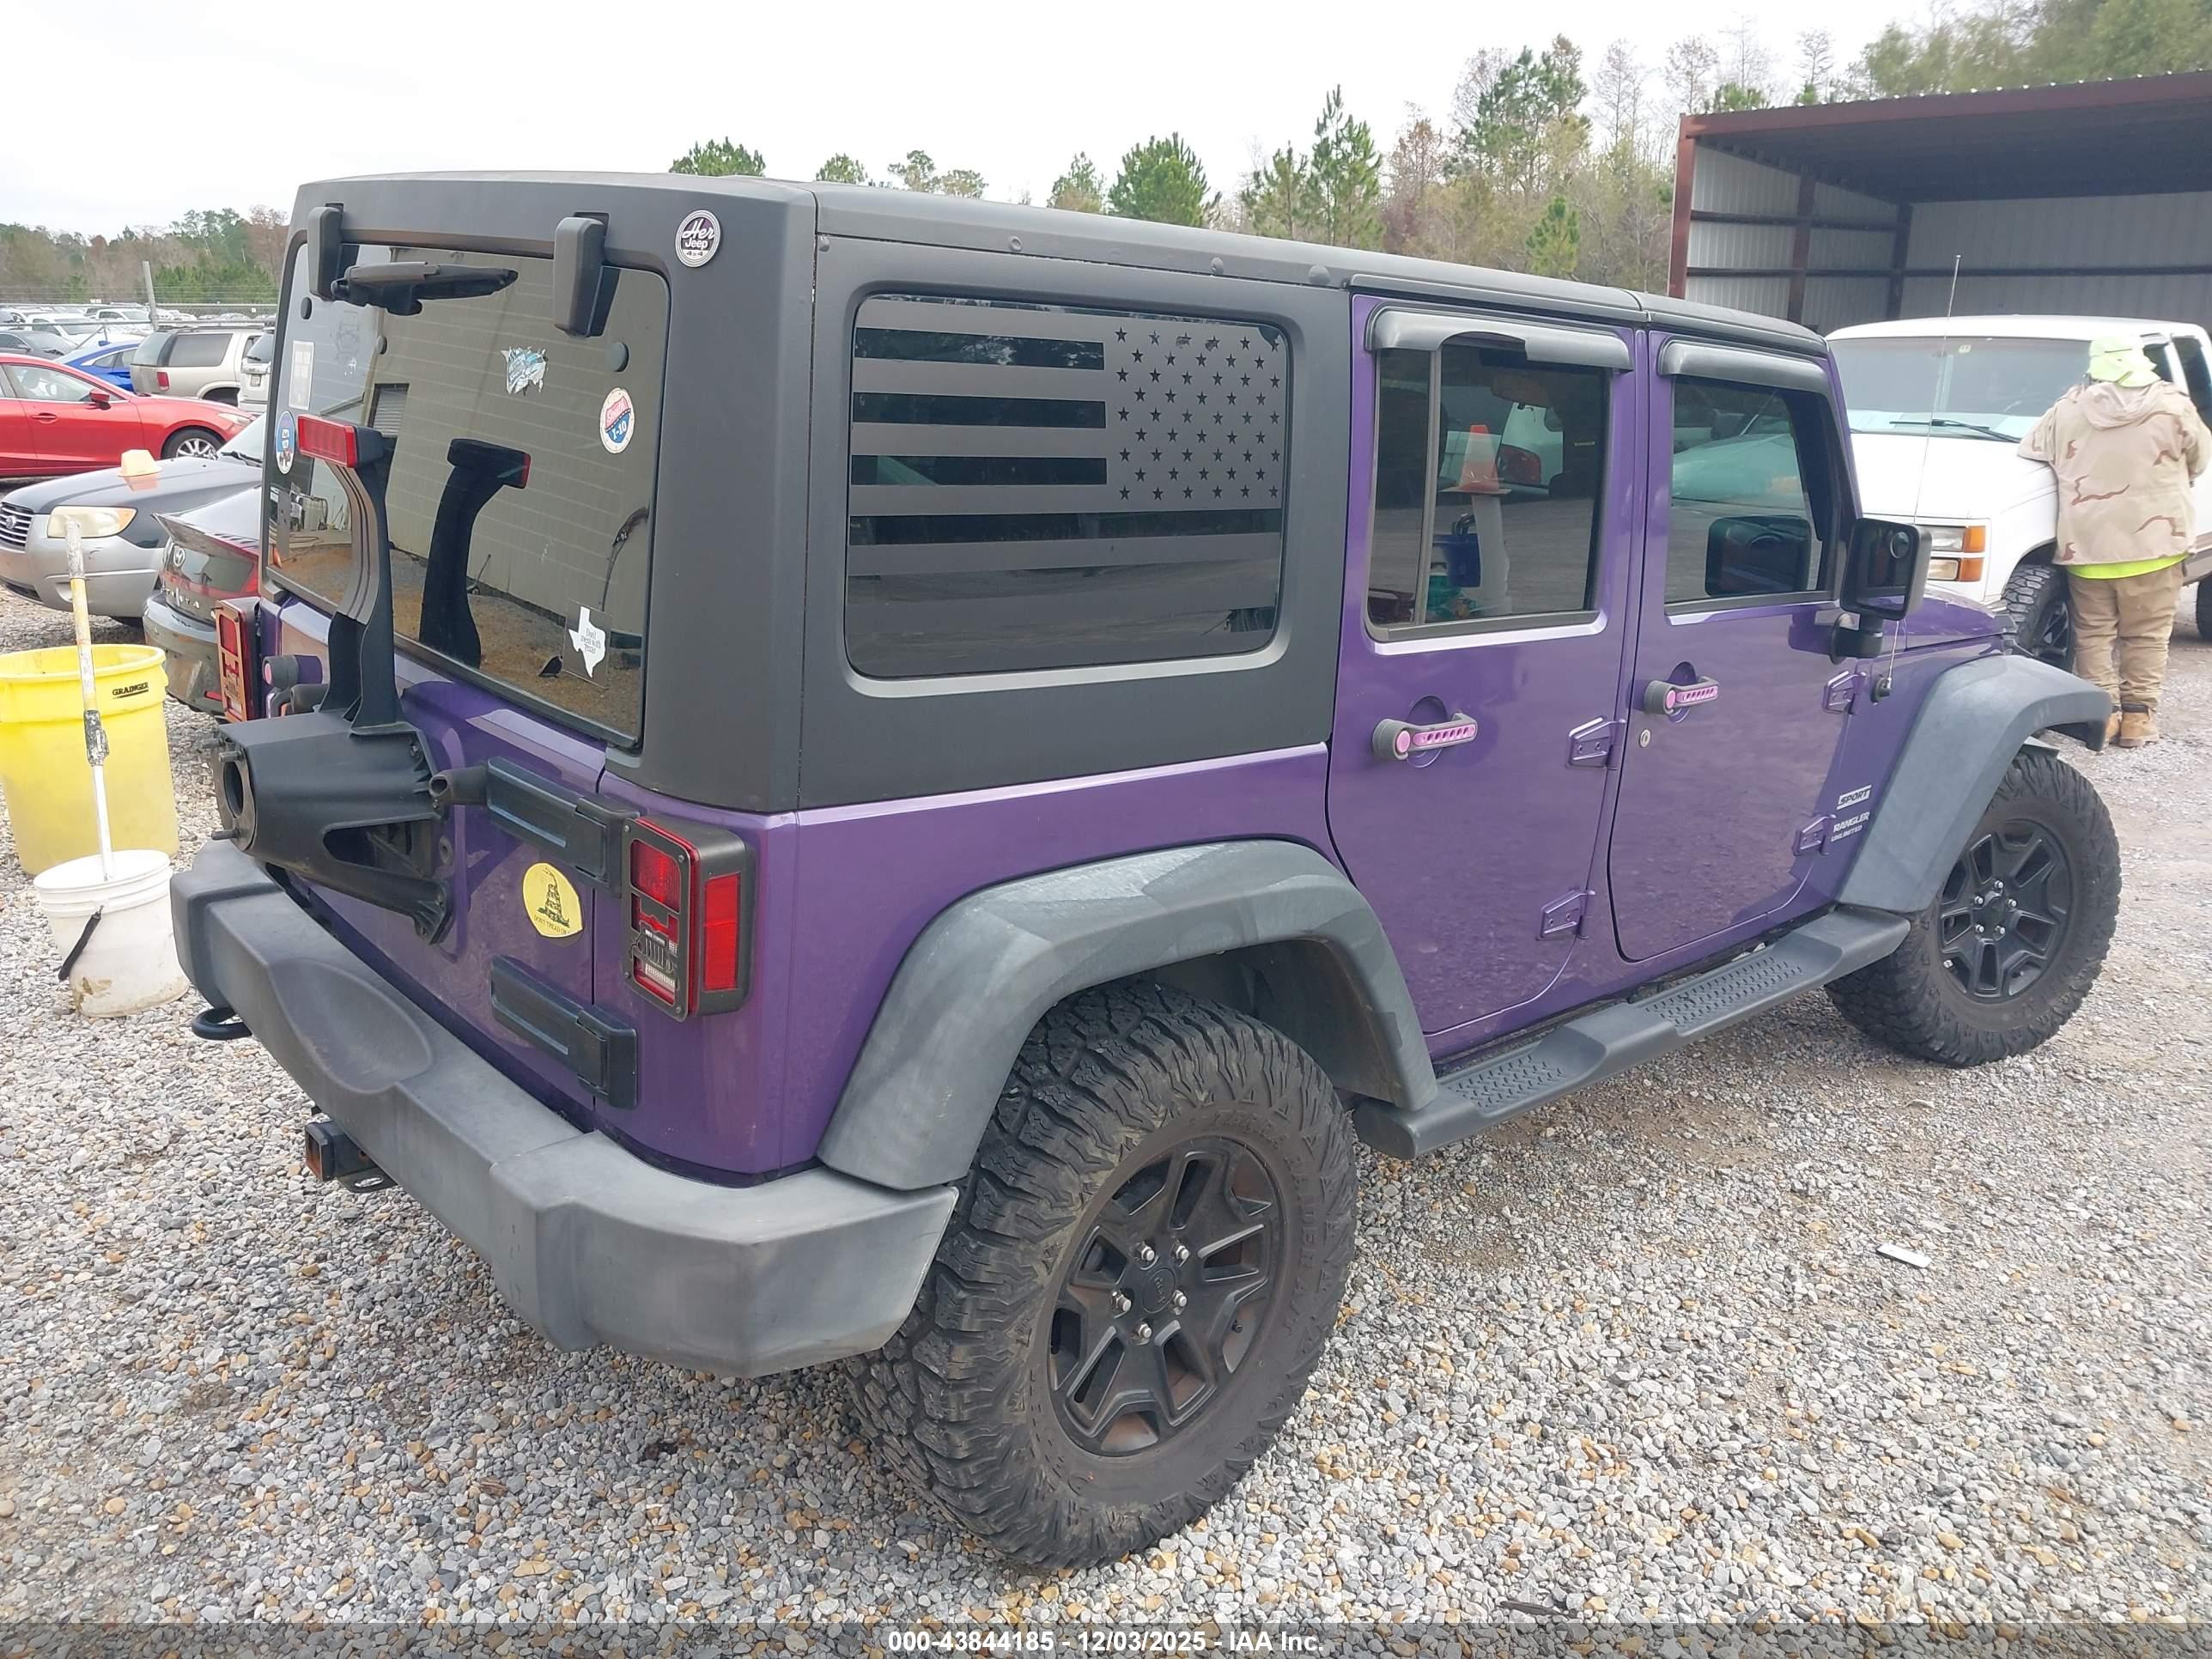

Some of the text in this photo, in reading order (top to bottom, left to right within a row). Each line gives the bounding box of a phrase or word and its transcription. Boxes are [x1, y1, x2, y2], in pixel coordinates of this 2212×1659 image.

[682, 218, 714, 240] Her
[684, 237, 708, 250] Jeep
[612, 421, 627, 440] I-10
[112, 682, 149, 696] GRAINGER
[1840, 790, 1869, 804] SPORT
